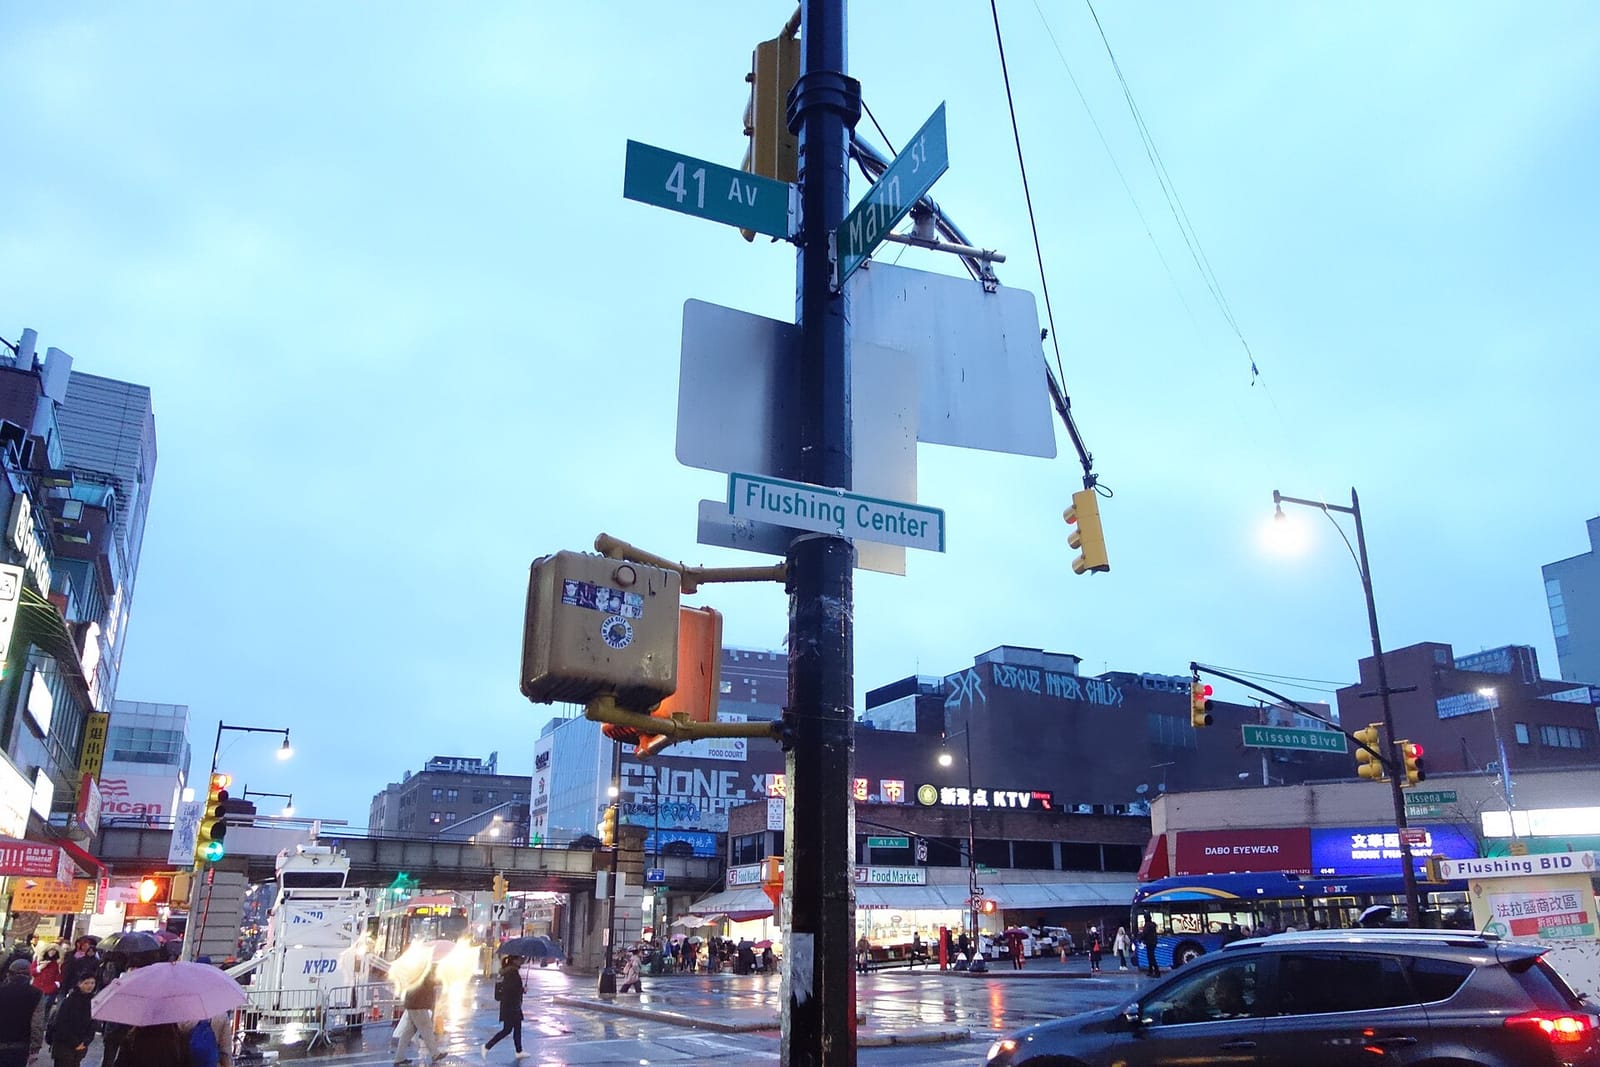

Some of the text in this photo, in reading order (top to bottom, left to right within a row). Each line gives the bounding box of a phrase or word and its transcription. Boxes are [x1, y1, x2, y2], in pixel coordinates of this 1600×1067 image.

[665, 161, 758, 209] 41 Av
[850, 136, 926, 257] Main St
[746, 483, 929, 539] Flushing Center
[1255, 731, 1337, 747] Kissena Blvd
[708, 749, 724, 757] FOOD
[994, 791, 1030, 808] KTV
[1410, 806, 1428, 815] Main
[1205, 846, 1279, 855] DABO EYEWEAR
[1458, 856, 1572, 873] Flushing BID
[872, 870, 919, 883] Food Market
[303, 959, 337, 974] NYPD
